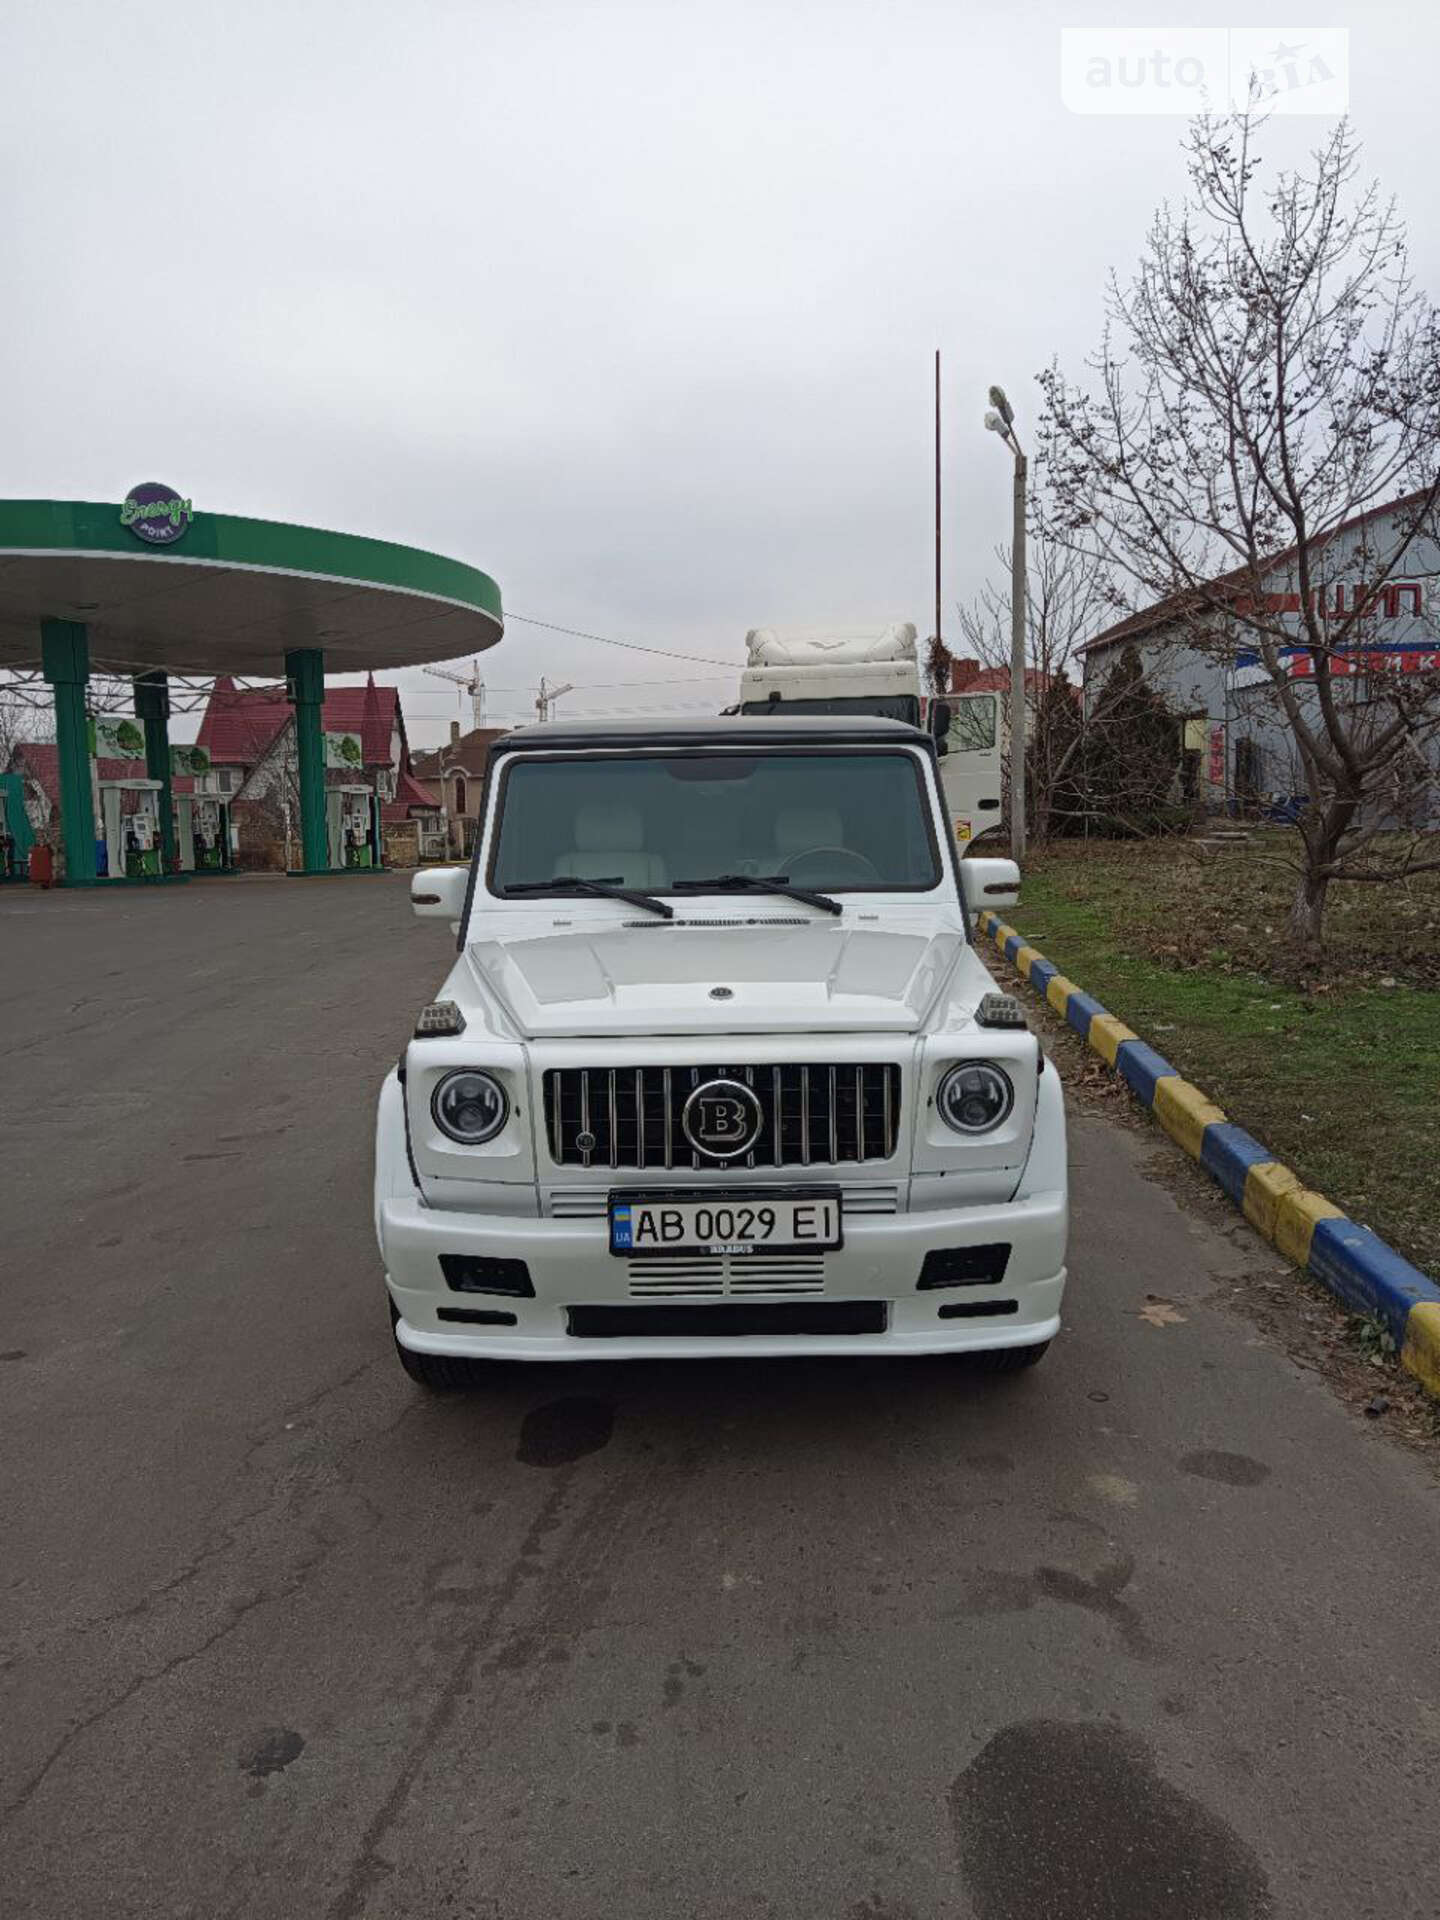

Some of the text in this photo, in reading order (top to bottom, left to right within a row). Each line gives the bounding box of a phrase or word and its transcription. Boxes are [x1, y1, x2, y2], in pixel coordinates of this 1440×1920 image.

[120, 498, 193, 526] Energy
[698, 1097, 748, 1142] B
[615, 1232, 631, 1243] UA
[636, 1206, 830, 1242] AB 0029 EI
